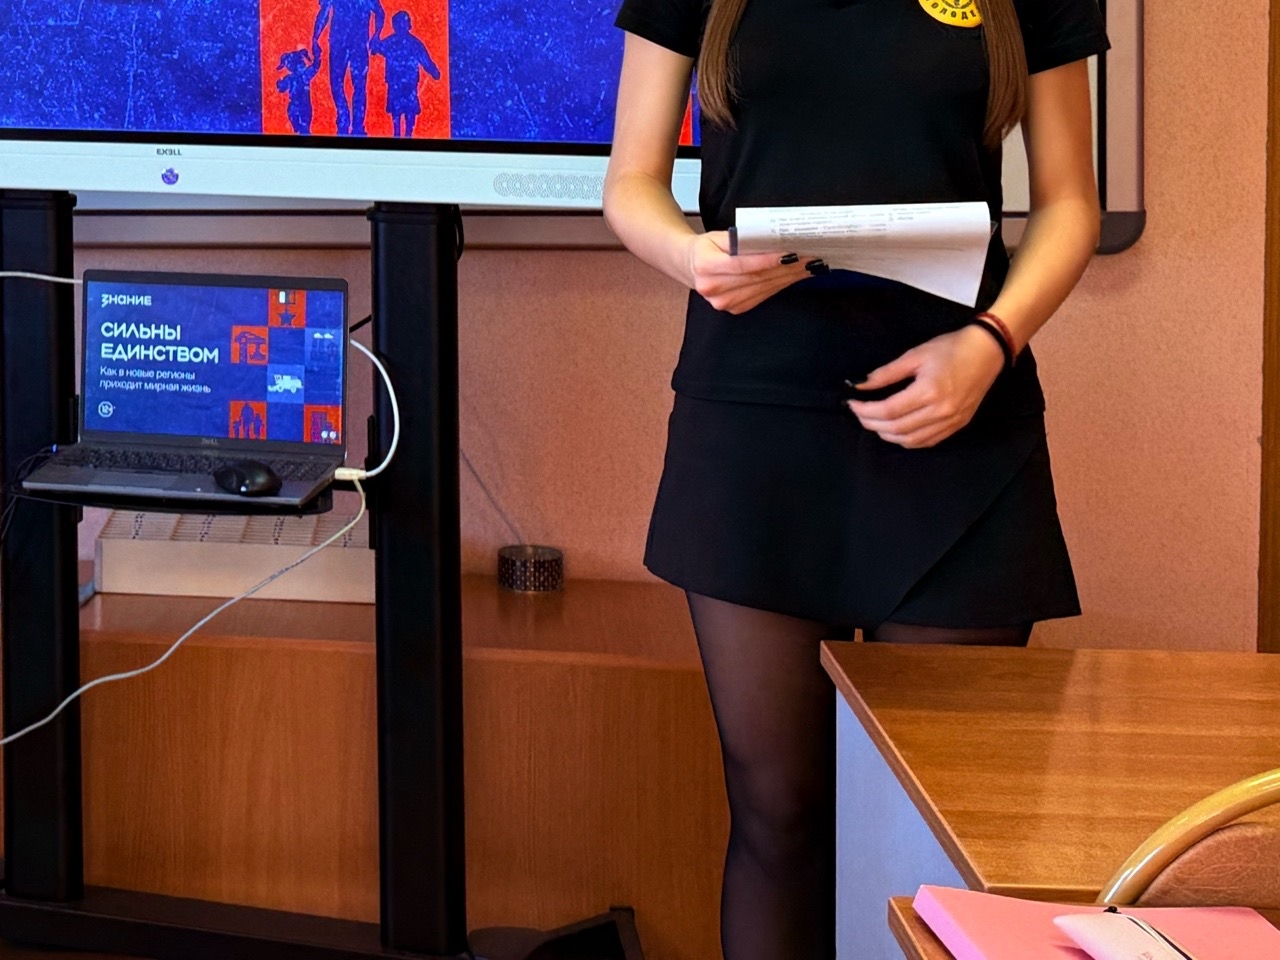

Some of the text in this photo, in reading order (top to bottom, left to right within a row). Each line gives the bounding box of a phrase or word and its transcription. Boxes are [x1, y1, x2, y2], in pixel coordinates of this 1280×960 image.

[100, 322, 181, 340] СИЛЬНЫ
[101, 343, 218, 363] ЕДИНСТВОМ
[100, 366, 195, 380] Как в новые регионы
[99, 379, 211, 393] приходит мирная жизнь
